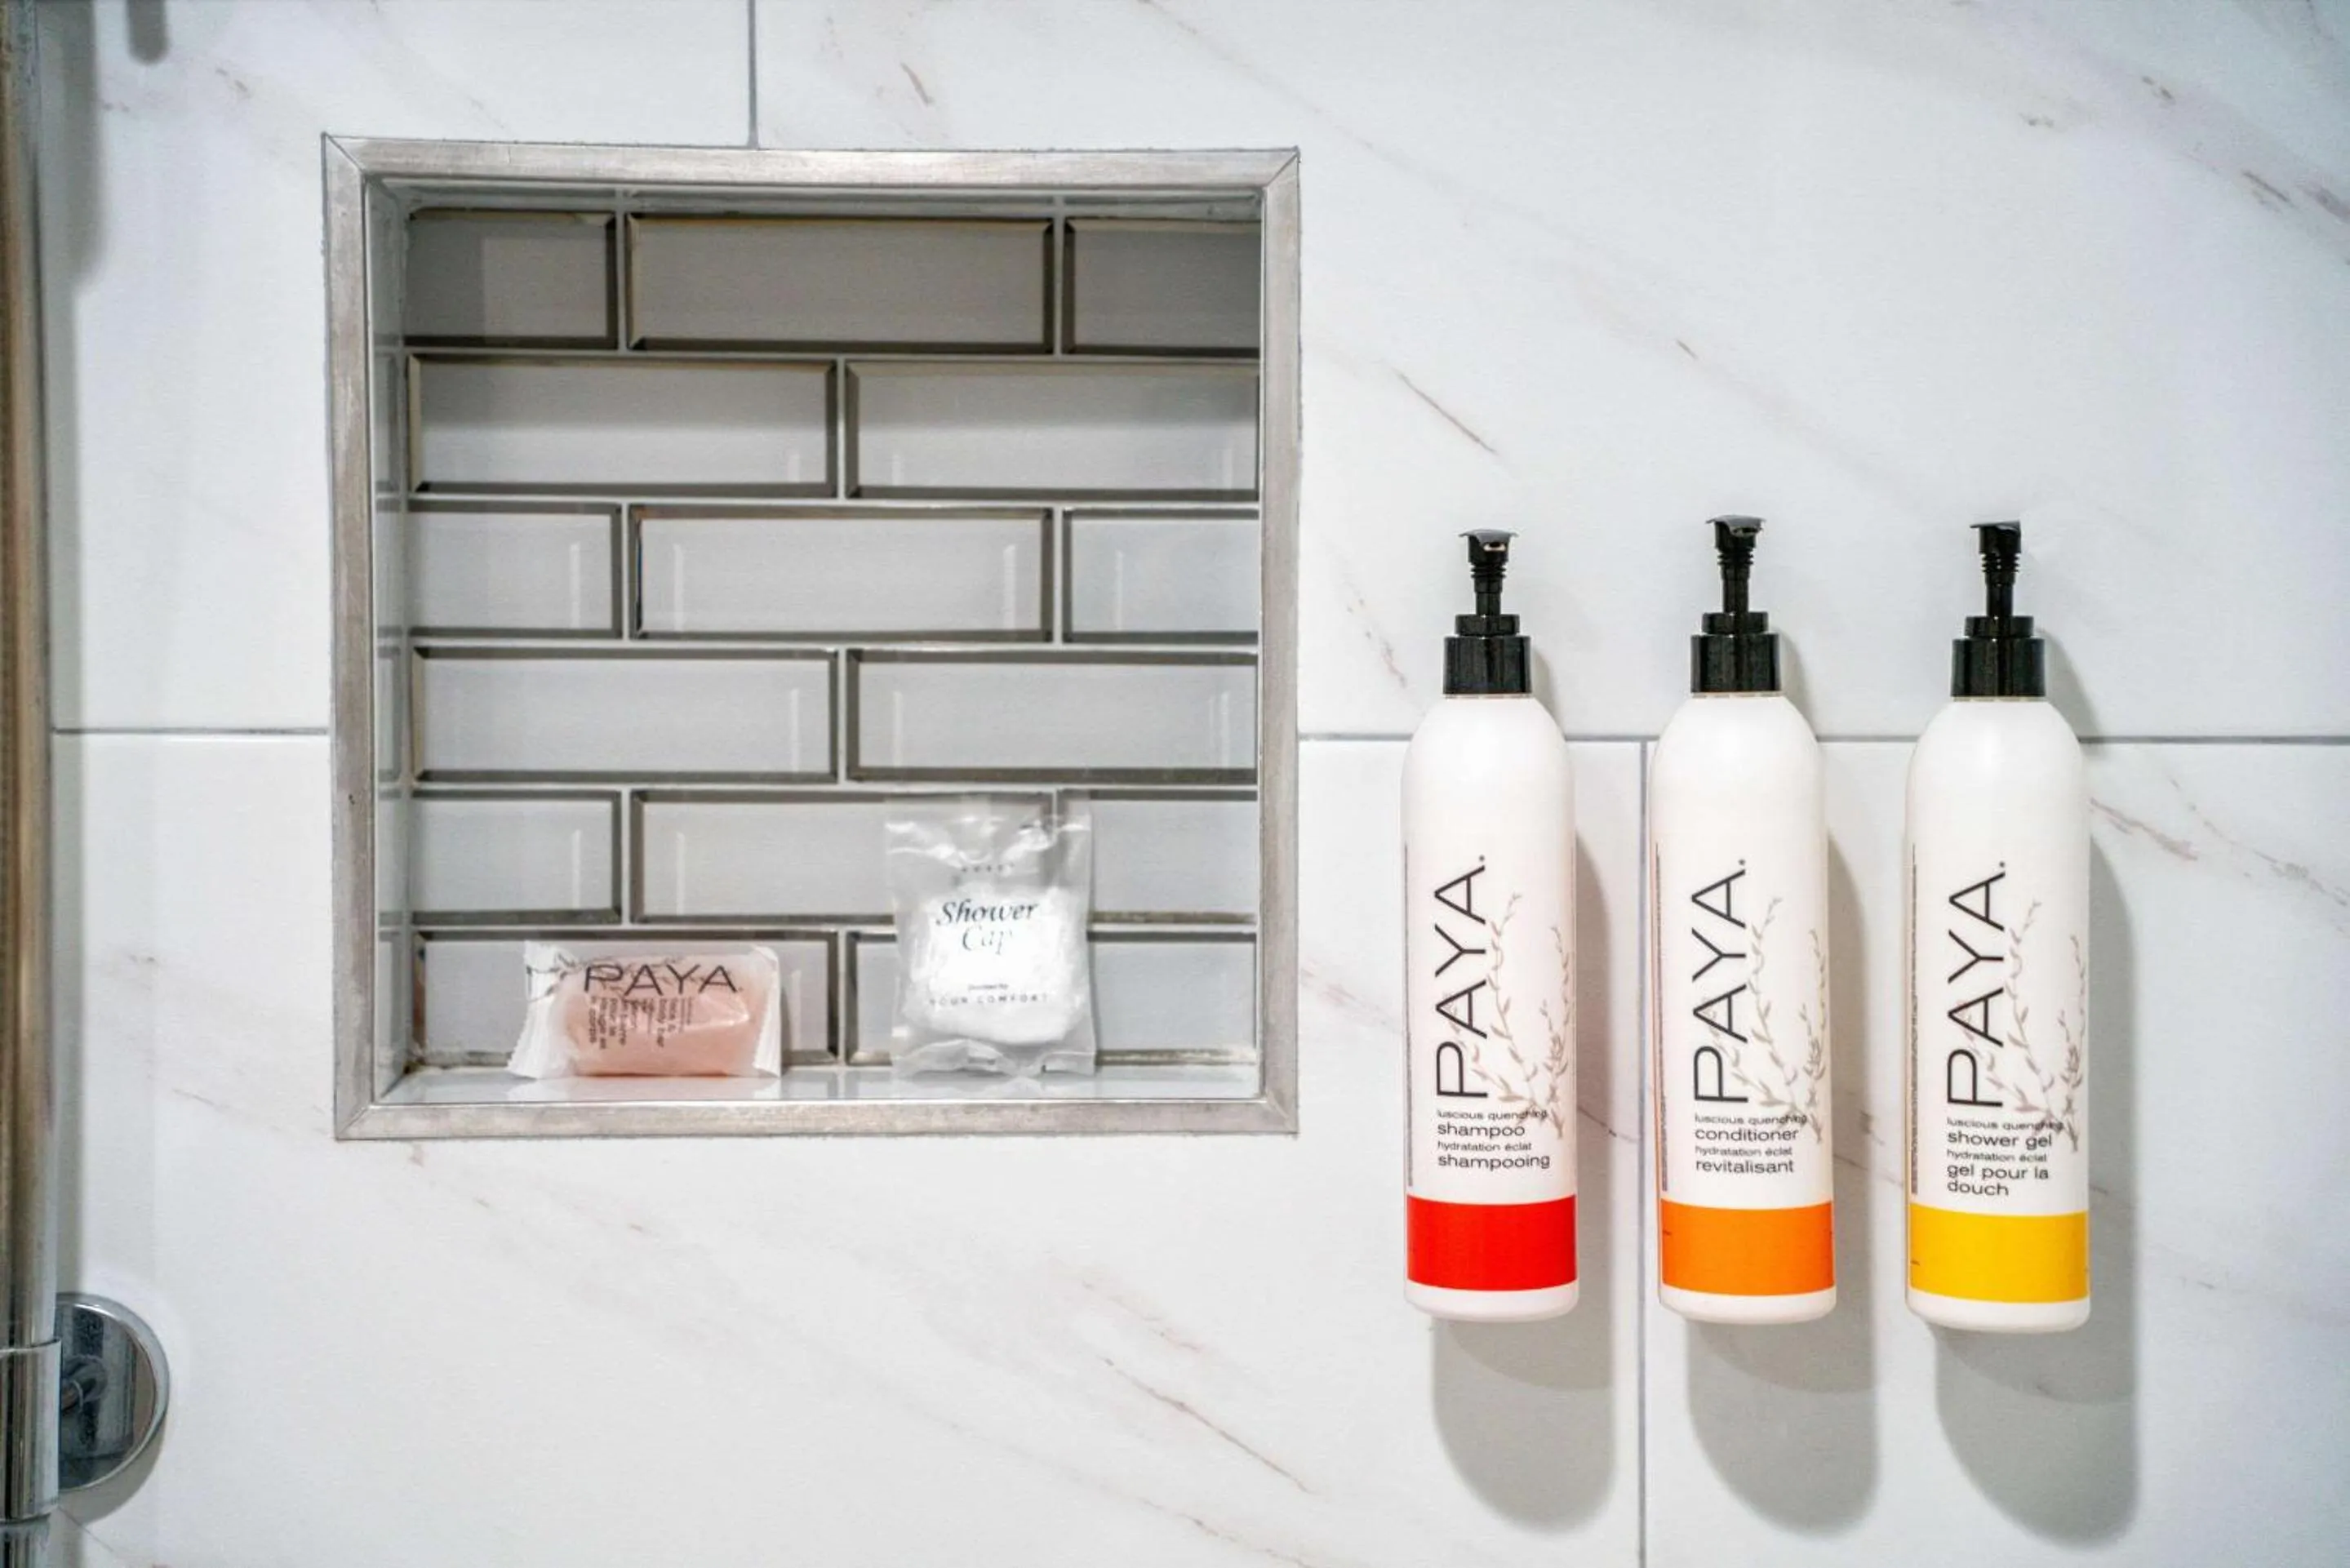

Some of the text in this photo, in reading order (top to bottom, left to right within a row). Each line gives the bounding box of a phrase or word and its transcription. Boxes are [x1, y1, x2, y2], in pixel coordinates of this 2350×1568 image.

[936, 899, 1039, 926] Shower
[1437, 1110, 1484, 1120] luscious
[1695, 1113, 1744, 1124] luscious
[1437, 1122, 1526, 1138] shampoo
[1947, 1117, 1998, 1129] luscious
[1695, 1128, 1799, 1142] conditioner
[1948, 1130, 2052, 1150] shower gel
[1437, 1141, 1500, 1152] hydratation
[1695, 1146, 1761, 1157] hydratation
[1437, 1153, 1550, 1170] shampooing
[1947, 1150, 2015, 1162] hydratation
[1696, 1160, 1794, 1174] revitalisant
[1947, 1164, 2050, 1182] gel pour la
[1947, 1180, 2009, 1196] douch
